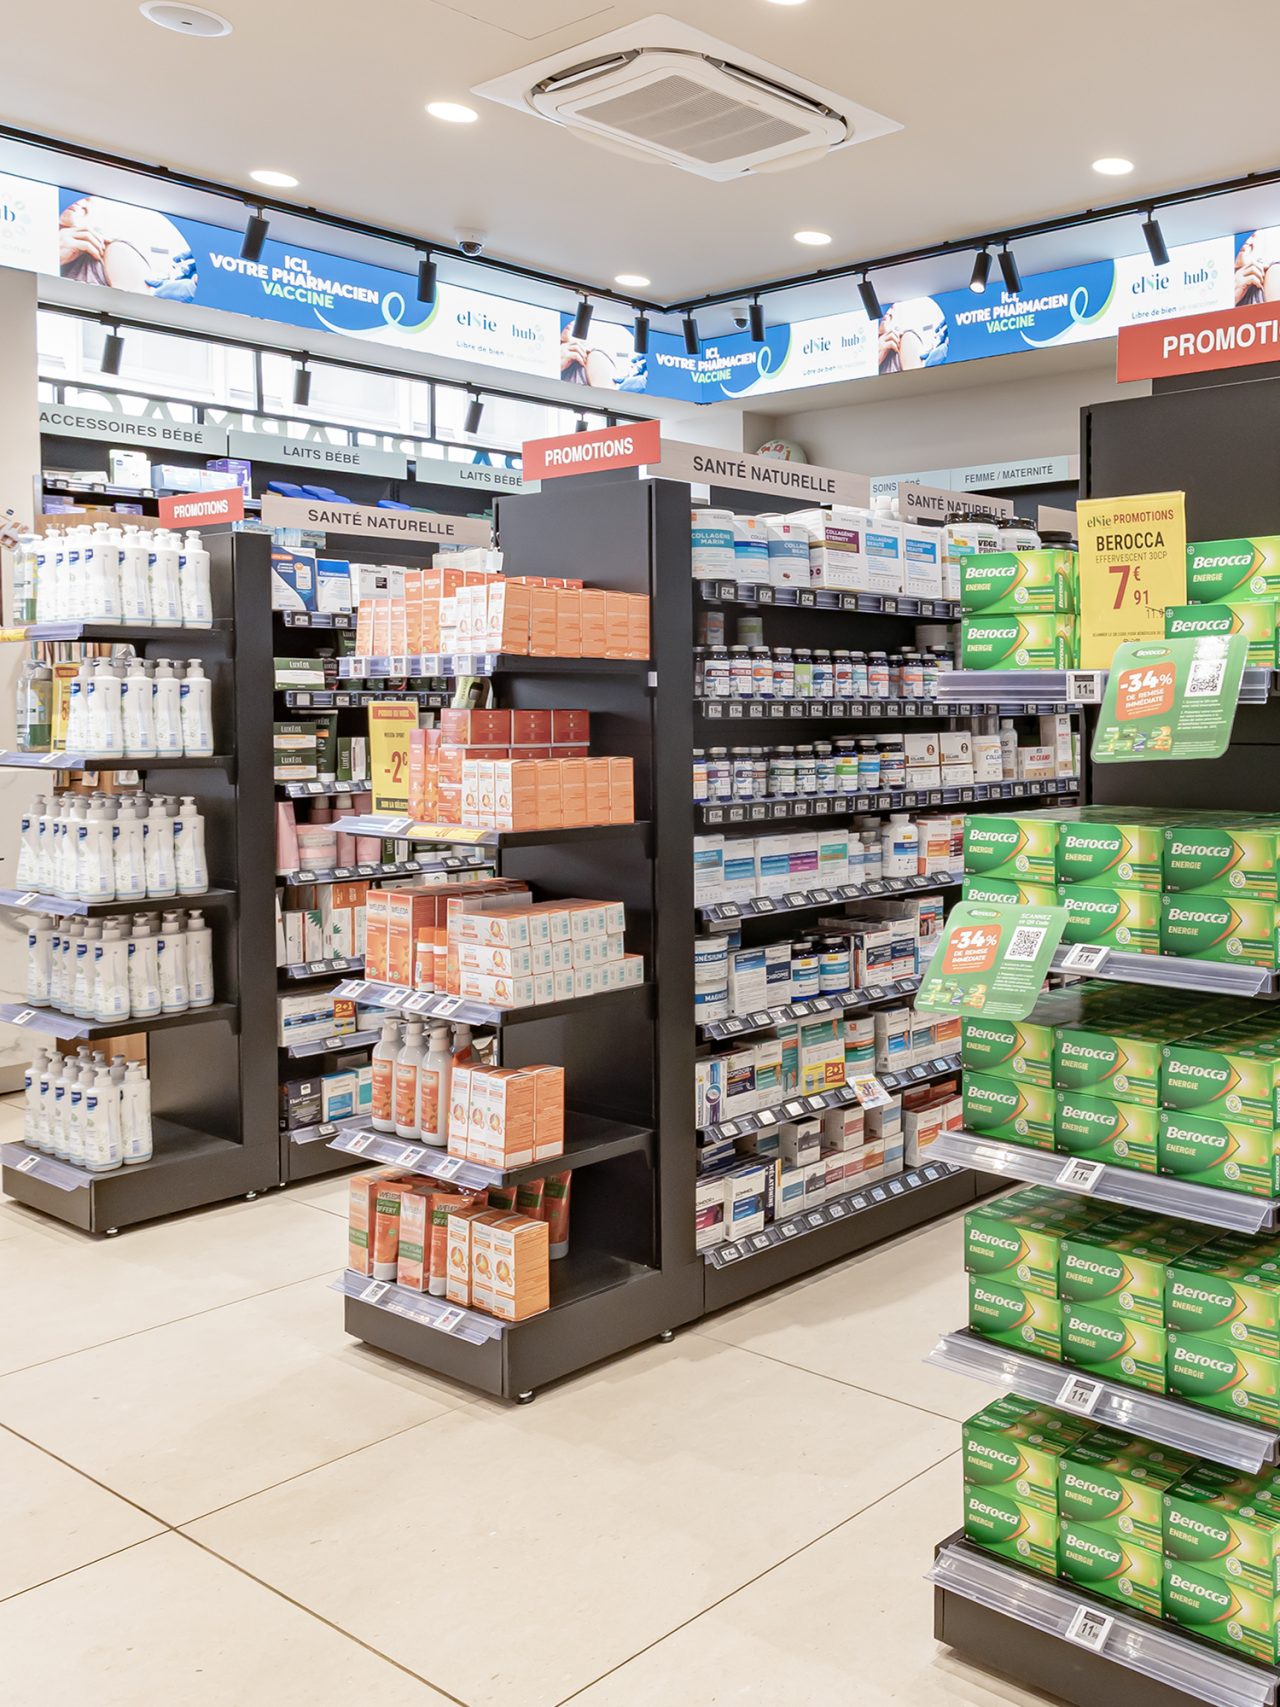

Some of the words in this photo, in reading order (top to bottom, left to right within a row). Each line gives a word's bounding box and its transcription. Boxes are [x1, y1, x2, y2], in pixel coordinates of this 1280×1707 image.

[284, 255, 312, 274] ICI,
[209, 252, 269, 279] VOTRE
[271, 267, 379, 304] PHARMACIEN
[1183, 268, 1209, 286] hub
[261, 280, 335, 309] VACCINE
[955, 309, 991, 326] VOTRE
[992, 294, 1069, 321] PHARMACIEN
[1130, 309, 1149, 320] Libre
[1151, 309, 1159, 317] de
[1161, 305, 1177, 315] bien
[512, 323, 536, 341] hub
[986, 314, 1036, 333] VACCINE
[456, 340, 475, 351] Libre
[477, 345, 488, 354] de
[489, 348, 504, 356] bien
[841, 334, 860, 348] hub
[656, 352, 696, 370] VOTRE
[698, 351, 757, 371] PHARMACIEN
[691, 369, 731, 383] VACCINE
[39, 412, 158, 438] ACCESSOIRES
[162, 426, 204, 444] BÉBÉ
[282, 445, 322, 460] LAITS
[325, 449, 361, 465] BÉBÉ
[544, 437, 634, 466] PROMOTIONS
[459, 469, 491, 485] LAITS
[494, 471, 522, 488] BÉBÉ
[692, 456, 747, 479] SANTÉ
[751, 466, 837, 494] NATURELLE
[964, 470, 996, 485] FEMME
[1004, 462, 1054, 482] MATERNITÉ
[872, 481, 898, 494] SOINS
[173, 499, 229, 518] PROMOTIONS
[907, 493, 944, 509] SANTÉ
[946, 499, 1007, 518] NATURELLE
[307, 508, 363, 526] SANTÉ
[366, 513, 456, 537] NATURELLE
[1113, 509, 1174, 524] PROMOTIONS
[1097, 532, 1164, 551] BEROCCA
[1096, 552, 1147, 564] EFFERVESCENT
[1149, 551, 1168, 560] 30CP
[1193, 553, 1252, 569] Berocca
[965, 565, 1016, 579] Berocca
[1133, 566, 1141, 581] €
[1193, 573, 1223, 582] ENERGIE
[965, 583, 991, 591] ENERGIE
[1109, 565, 1130, 610] 7
[1134, 590, 1149, 605] 91
[1146, 609, 1164, 619] 11.9
[968, 628, 1017, 639] Berocca
[1171, 618, 1230, 632] Berocca
[967, 644, 992, 652] ENERGIE
[1136, 649, 1166, 657] Berocca
[1120, 670, 1172, 692] -34%
[1125, 696, 1164, 708] IMMÉDIATE
[1138, 688, 1164, 699] REMISE
[969, 829, 1018, 843] Berocca
[1065, 836, 1119, 850] Berocca
[969, 846, 994, 854] ENERGIE
[1065, 853, 1093, 862] ENERGIE
[1171, 842, 1231, 857] Berocca
[1171, 860, 1202, 869] ENERGIE
[967, 890, 1018, 903] Berocca
[1063, 899, 1118, 914] Berocca
[1065, 916, 1091, 925] NERGIE
[1168, 908, 1228, 924] Berocca
[951, 930, 997, 947] -34%
[1168, 926, 1199, 936] ENERGIE
[952, 955, 987, 963] IMMÉDIATE
[966, 1026, 1014, 1044] Berocca
[1062, 1043, 1115, 1061] Berocca
[1168, 1061, 1227, 1080] Berocca
[1168, 1078, 1199, 1090] ENERGIE
[968, 1086, 1017, 1105] Berocca
[1062, 1106, 1115, 1126] Berocca
[1166, 1126, 1225, 1147] Berocca
[1166, 1144, 1197, 1156] ENERGIE
[969, 1229, 1019, 1251] Berocca
[1066, 1255, 1121, 1278] Berocca
[974, 1288, 1024, 1312] Berocca
[1172, 1283, 1233, 1307] Berocca
[1172, 1300, 1203, 1314] ENERGIE
[1069, 1318, 1123, 1342] Berocca
[1174, 1347, 1234, 1373] Berocca
[968, 1441, 1017, 1466] Berocca
[1064, 1474, 1120, 1501] Berocca
[969, 1498, 1018, 1525] Berocca
[1169, 1511, 1228, 1542] Berocca
[1169, 1527, 1199, 1545] ENERGIE
[1066, 1534, 1120, 1563] Berocca
[1170, 1574, 1229, 1605] Berocca
